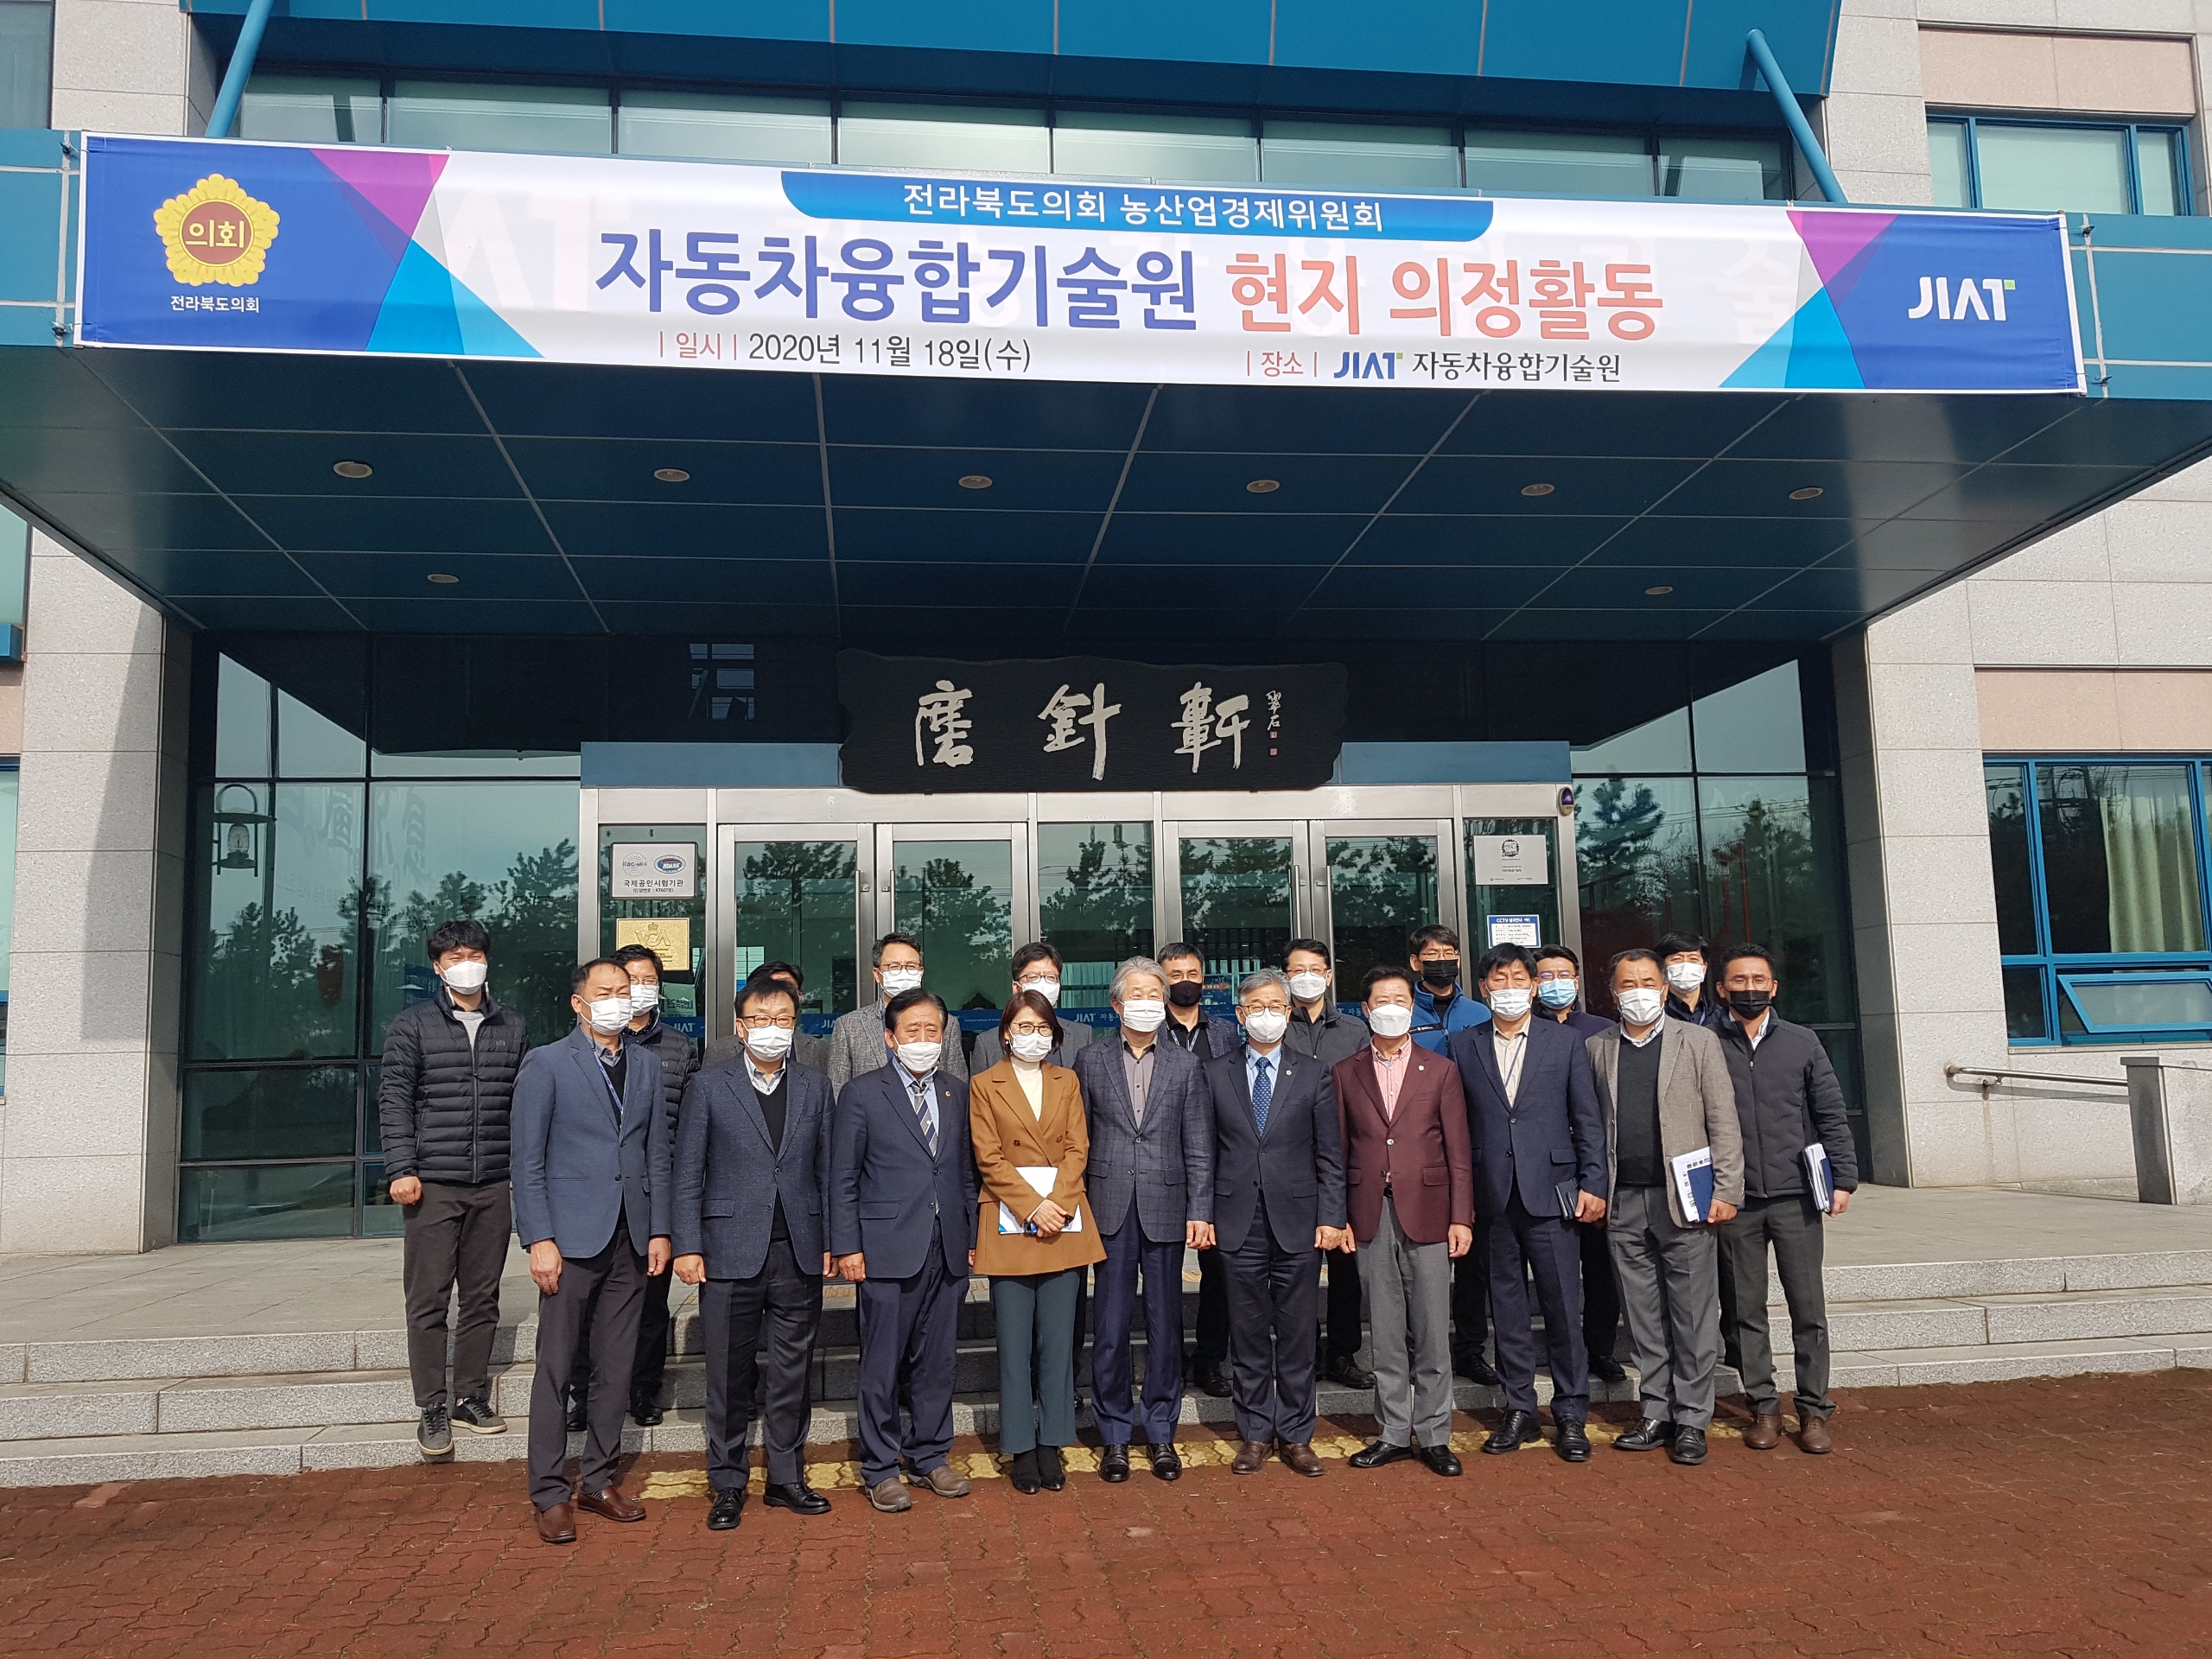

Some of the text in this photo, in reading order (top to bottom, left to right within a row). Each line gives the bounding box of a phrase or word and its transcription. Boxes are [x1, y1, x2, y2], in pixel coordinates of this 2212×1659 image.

[903, 182, 1383, 232] 전라북도의회 농산업경제위원회
[185, 219, 245, 248] 의회
[595, 228, 1197, 331] 자동차융합기술원
[1226, 253, 1360, 335] 현지
[1390, 257, 1663, 341] 의정활동
[1908, 276, 2016, 321] JIAT
[170, 295, 260, 314] 전라북도의회
[748, 333, 841, 365] 2020년
[855, 335, 912, 368] 11월
[924, 338, 1031, 372] 18일(수)
[1333, 351, 1404, 380] JIAT
[1412, 351, 1621, 383] 자동차융합기술원
[1073, 1013, 1096, 1023] JIAT
